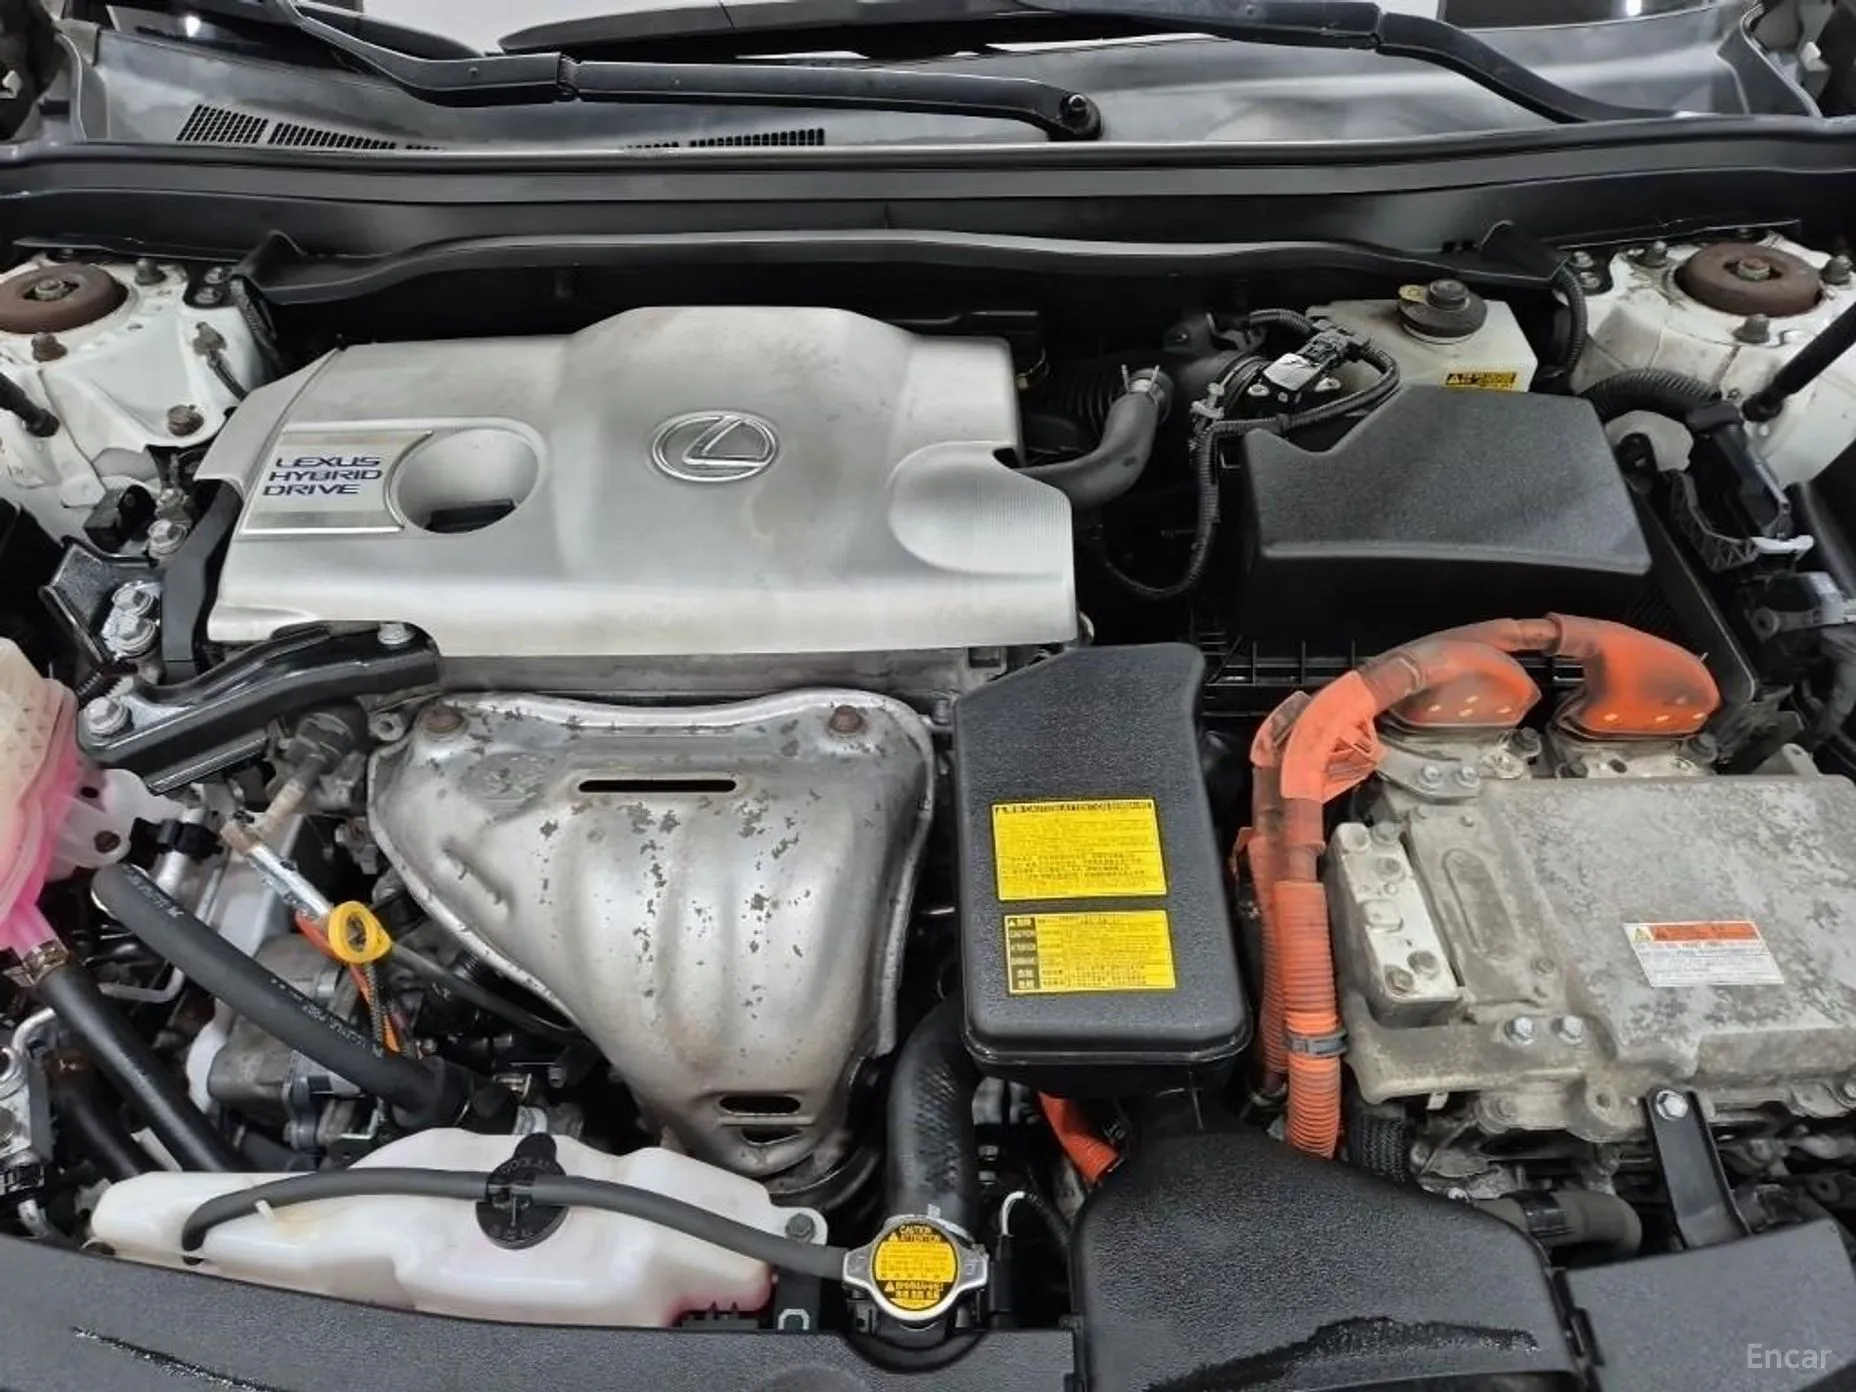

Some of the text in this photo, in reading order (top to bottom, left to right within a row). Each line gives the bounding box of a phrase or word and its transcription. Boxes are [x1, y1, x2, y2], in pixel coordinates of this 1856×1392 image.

[276, 457, 381, 468] LEXUS
[268, 470, 382, 481] HYBRID
[262, 484, 360, 496] DRIVE
